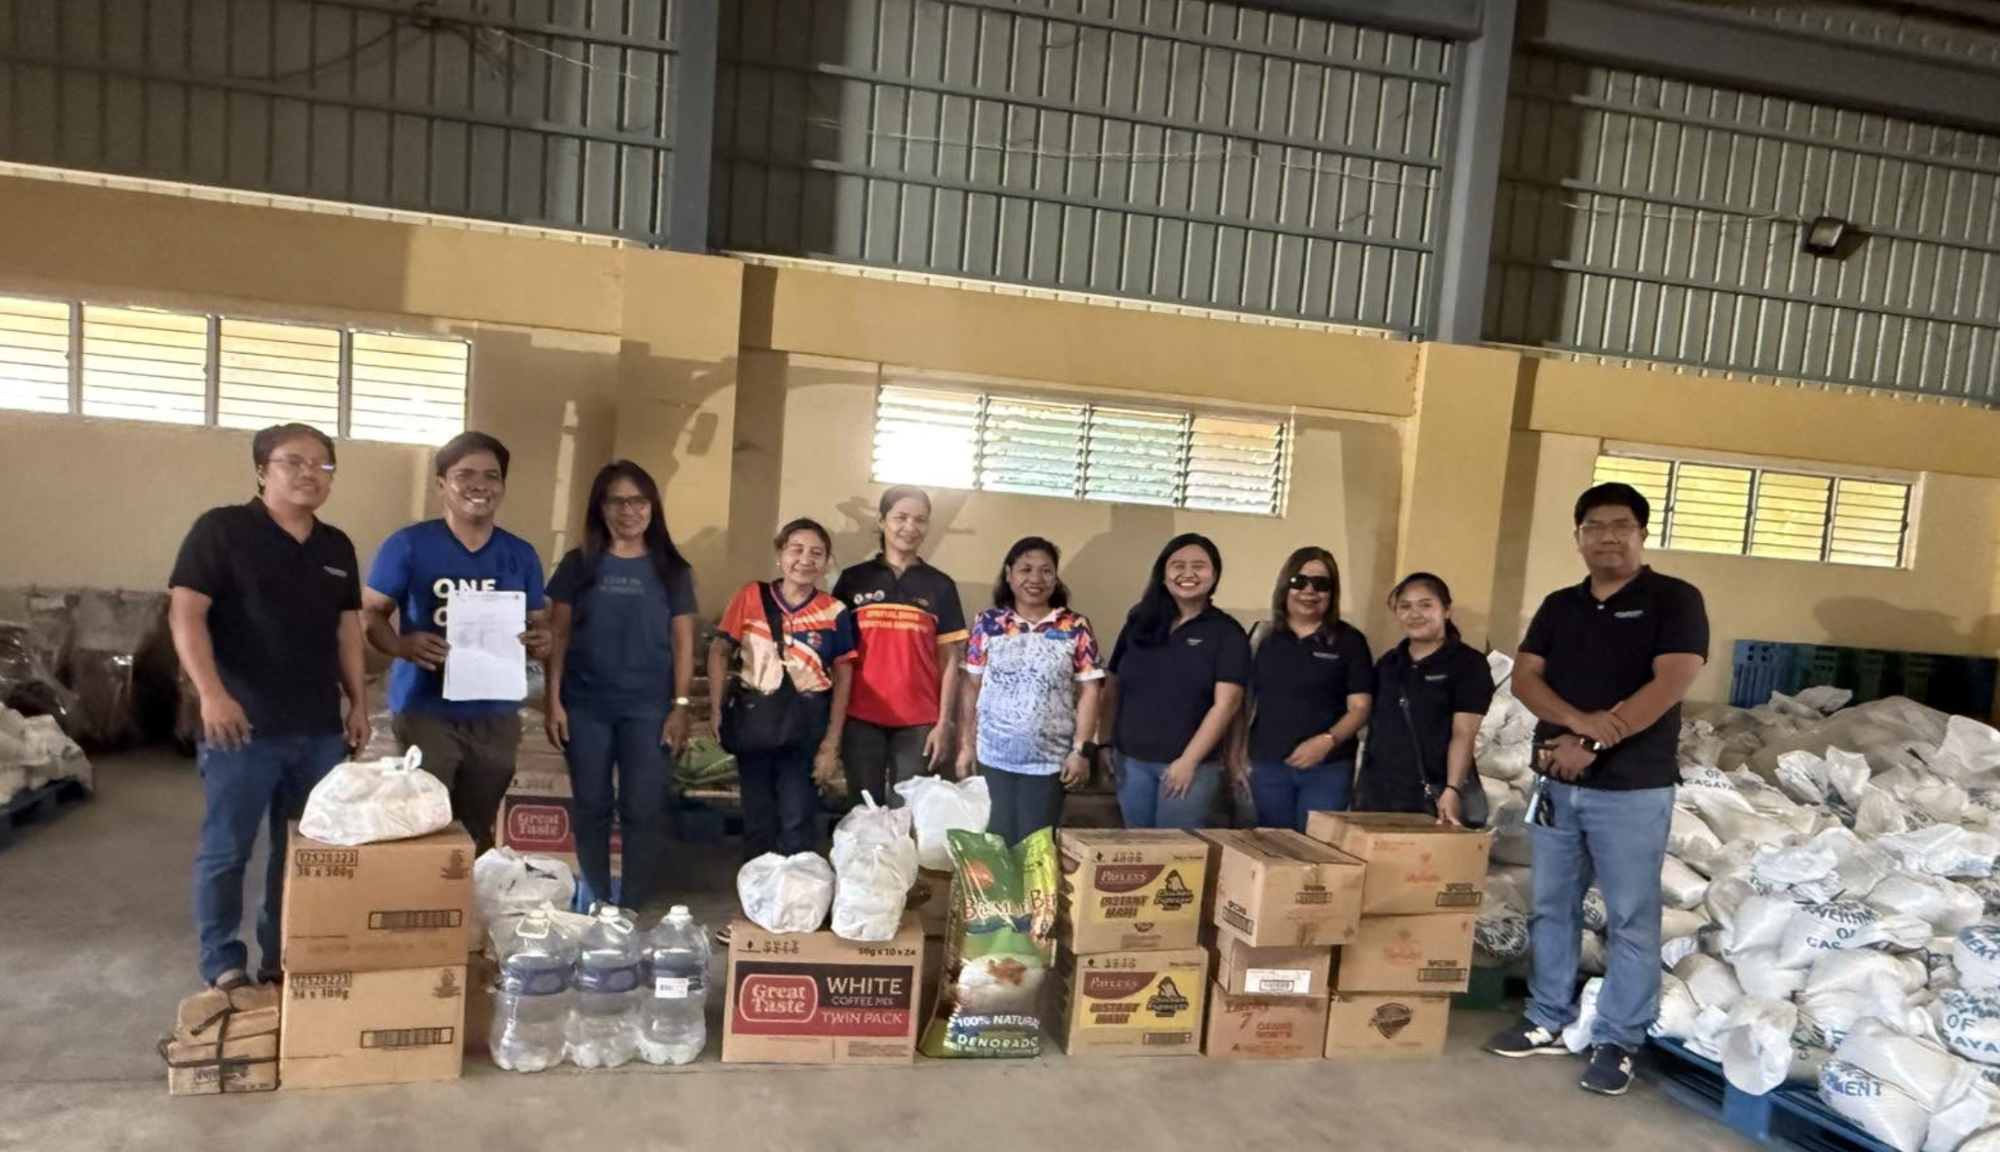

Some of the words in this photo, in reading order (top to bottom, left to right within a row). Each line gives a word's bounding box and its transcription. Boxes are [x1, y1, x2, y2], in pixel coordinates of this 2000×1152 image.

[517, 812, 560, 825] Great
[519, 824, 560, 837] Taste
[751, 984, 807, 1000] Great
[826, 977, 903, 995] WHITE
[751, 998, 806, 1013] Taste
[831, 996, 874, 1006] COFFEE
[820, 1011, 861, 1025] TWIN
[863, 1012, 903, 1024] PACK
[957, 1015, 991, 1028] 100%
[1946, 1013, 1976, 1032] OF
